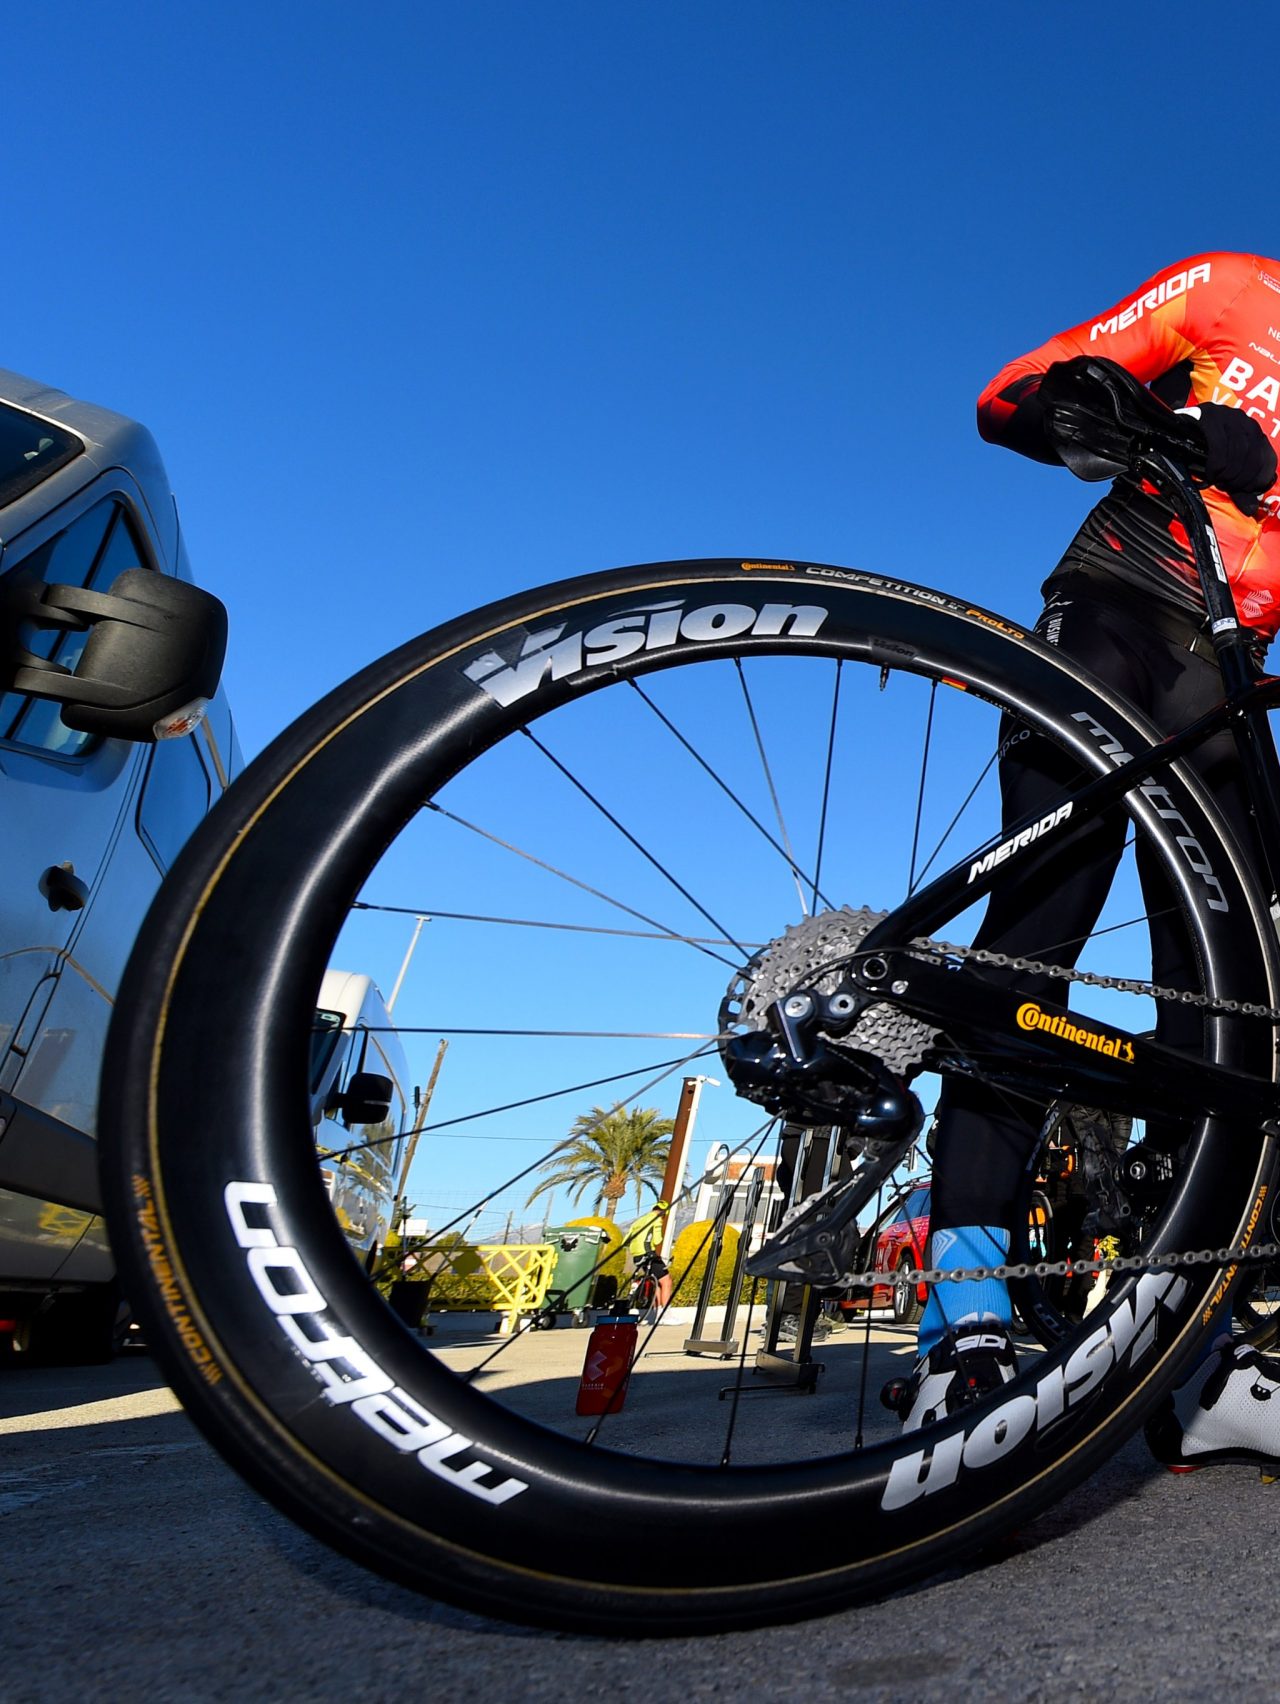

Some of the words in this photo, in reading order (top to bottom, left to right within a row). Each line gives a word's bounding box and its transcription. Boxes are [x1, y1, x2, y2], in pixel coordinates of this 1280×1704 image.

[1089, 262, 1211, 342] MERIDA
[805, 566, 949, 606] COMPETITION
[462, 599, 830, 709] Vision
[967, 801, 1074, 884] MERIDA
[1016, 1002, 1122, 1060] Continental
[137, 1200, 212, 1368] CONTINENTAL
[224, 1180, 530, 1506] metron
[879, 1270, 1191, 1512] Vision
